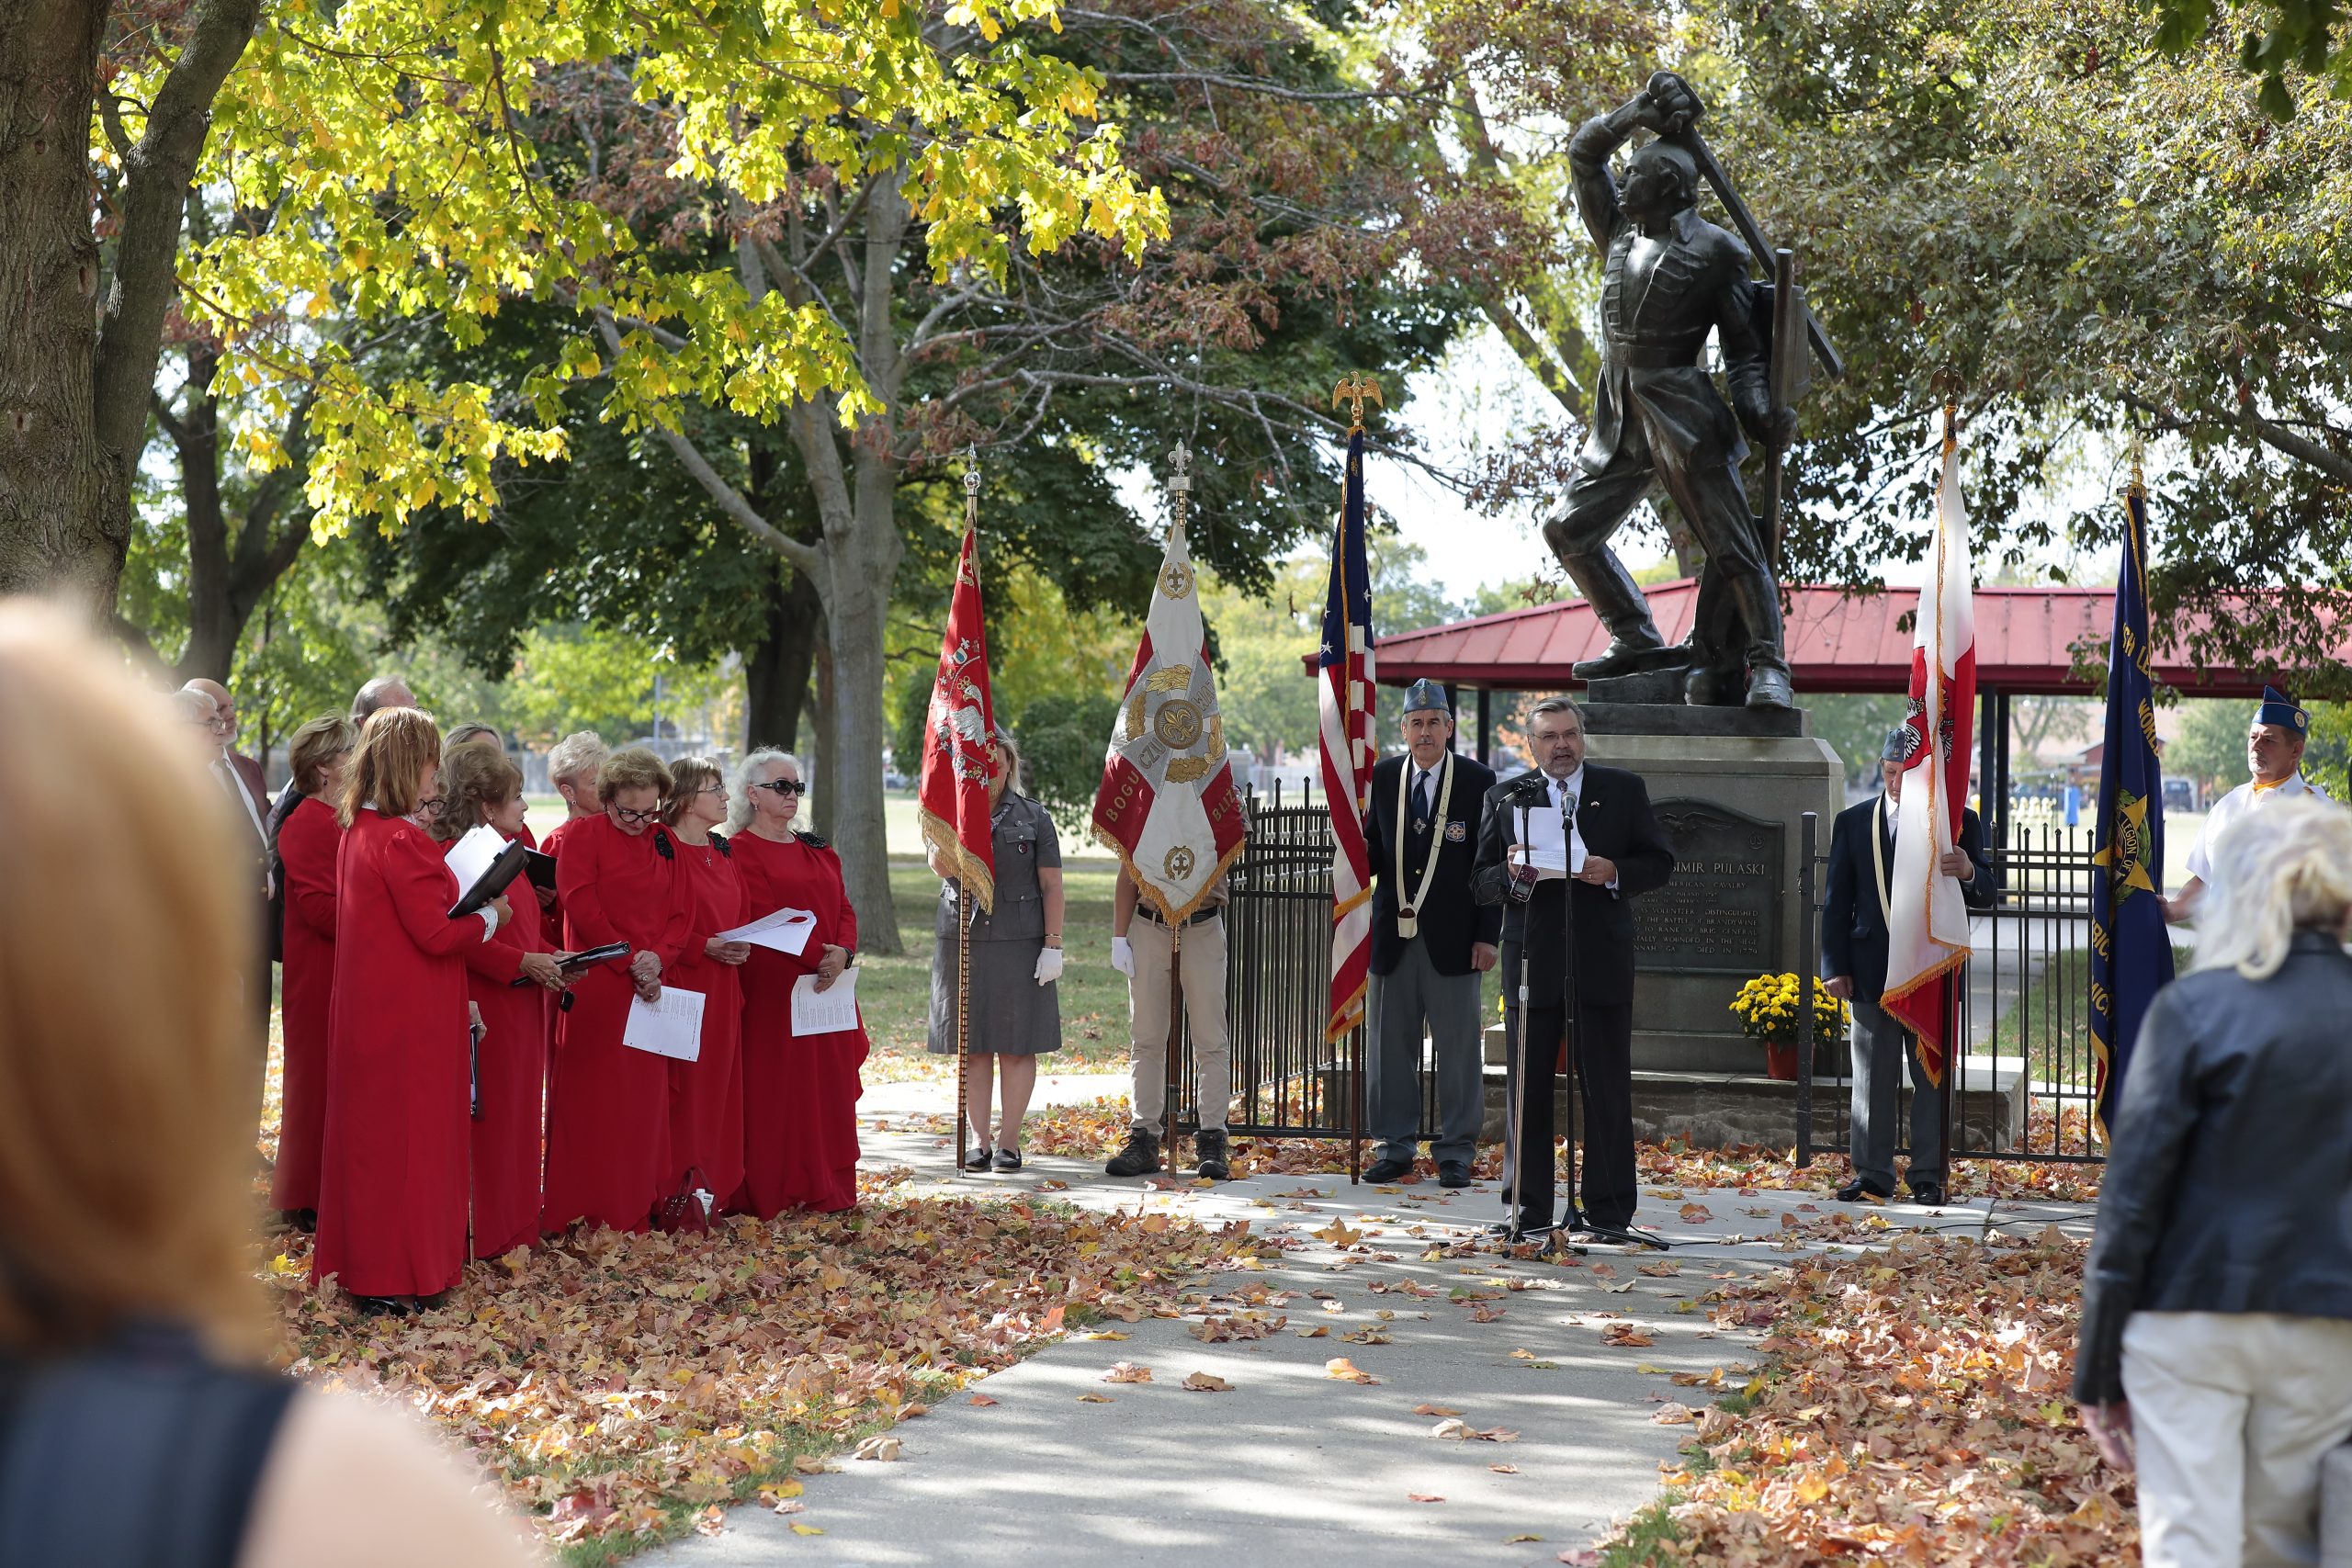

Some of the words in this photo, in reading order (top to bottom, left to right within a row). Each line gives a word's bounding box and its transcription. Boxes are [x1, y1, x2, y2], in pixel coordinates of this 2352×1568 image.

[1139, 737, 1166, 769] CZU
[1105, 770, 1139, 822] BOGU
[2121, 818, 2137, 854] LEGION
[1672, 862, 1705, 874] IMIR
[1713, 863, 1765, 875] PULASKI
[2121, 859, 2134, 872] OF
[1704, 908, 1758, 917] DISTINGUISHED
